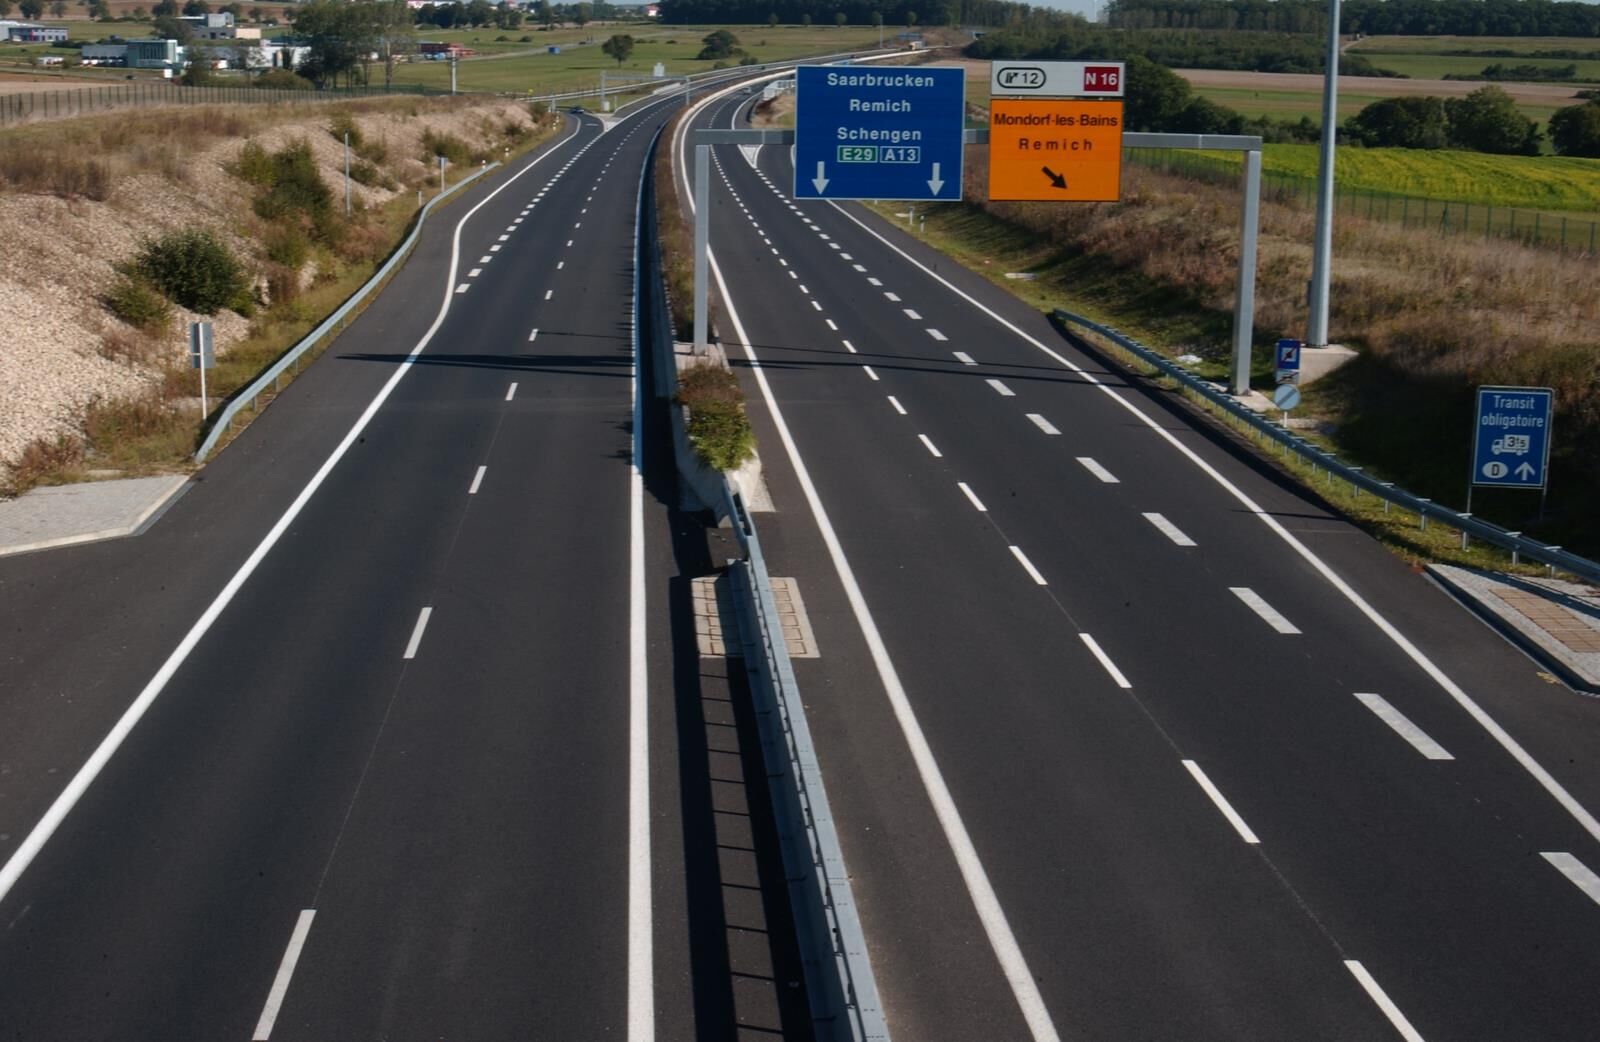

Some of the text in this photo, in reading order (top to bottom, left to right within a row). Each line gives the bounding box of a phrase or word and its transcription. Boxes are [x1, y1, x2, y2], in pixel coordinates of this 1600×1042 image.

[827, 72, 934, 87] Saarbrucken
[1022, 73, 1039, 85] 12
[1085, 73, 1117, 86] N 16
[850, 99, 911, 112] Remich
[994, 113, 1118, 127] Mondorf-les-Bains
[837, 127, 922, 143] Schengen
[1018, 138, 1092, 150] Remich
[842, 148, 873, 161] E29
[884, 149, 916, 161] A13
[1493, 395, 1535, 410] Transit
[1481, 413, 1544, 430] obligatoire
[1491, 463, 1500, 476] D
